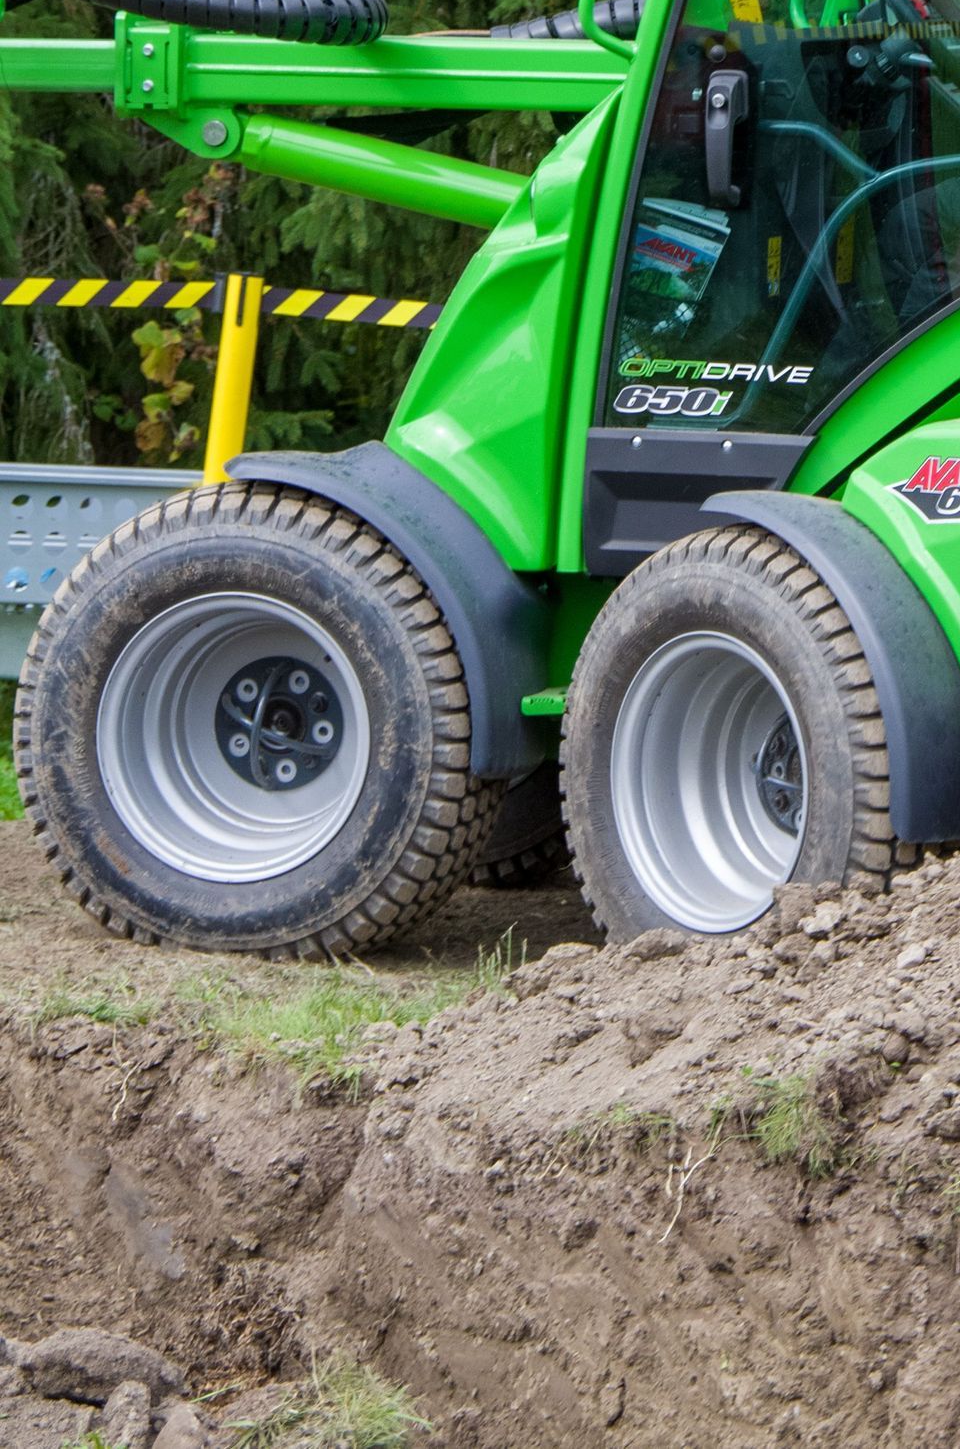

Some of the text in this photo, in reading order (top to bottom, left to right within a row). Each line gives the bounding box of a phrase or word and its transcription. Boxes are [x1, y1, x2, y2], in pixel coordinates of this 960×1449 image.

[639, 237, 698, 264] AVANT
[619, 358, 814, 383] OPTIDRIVE
[613, 384, 734, 416] 650i
